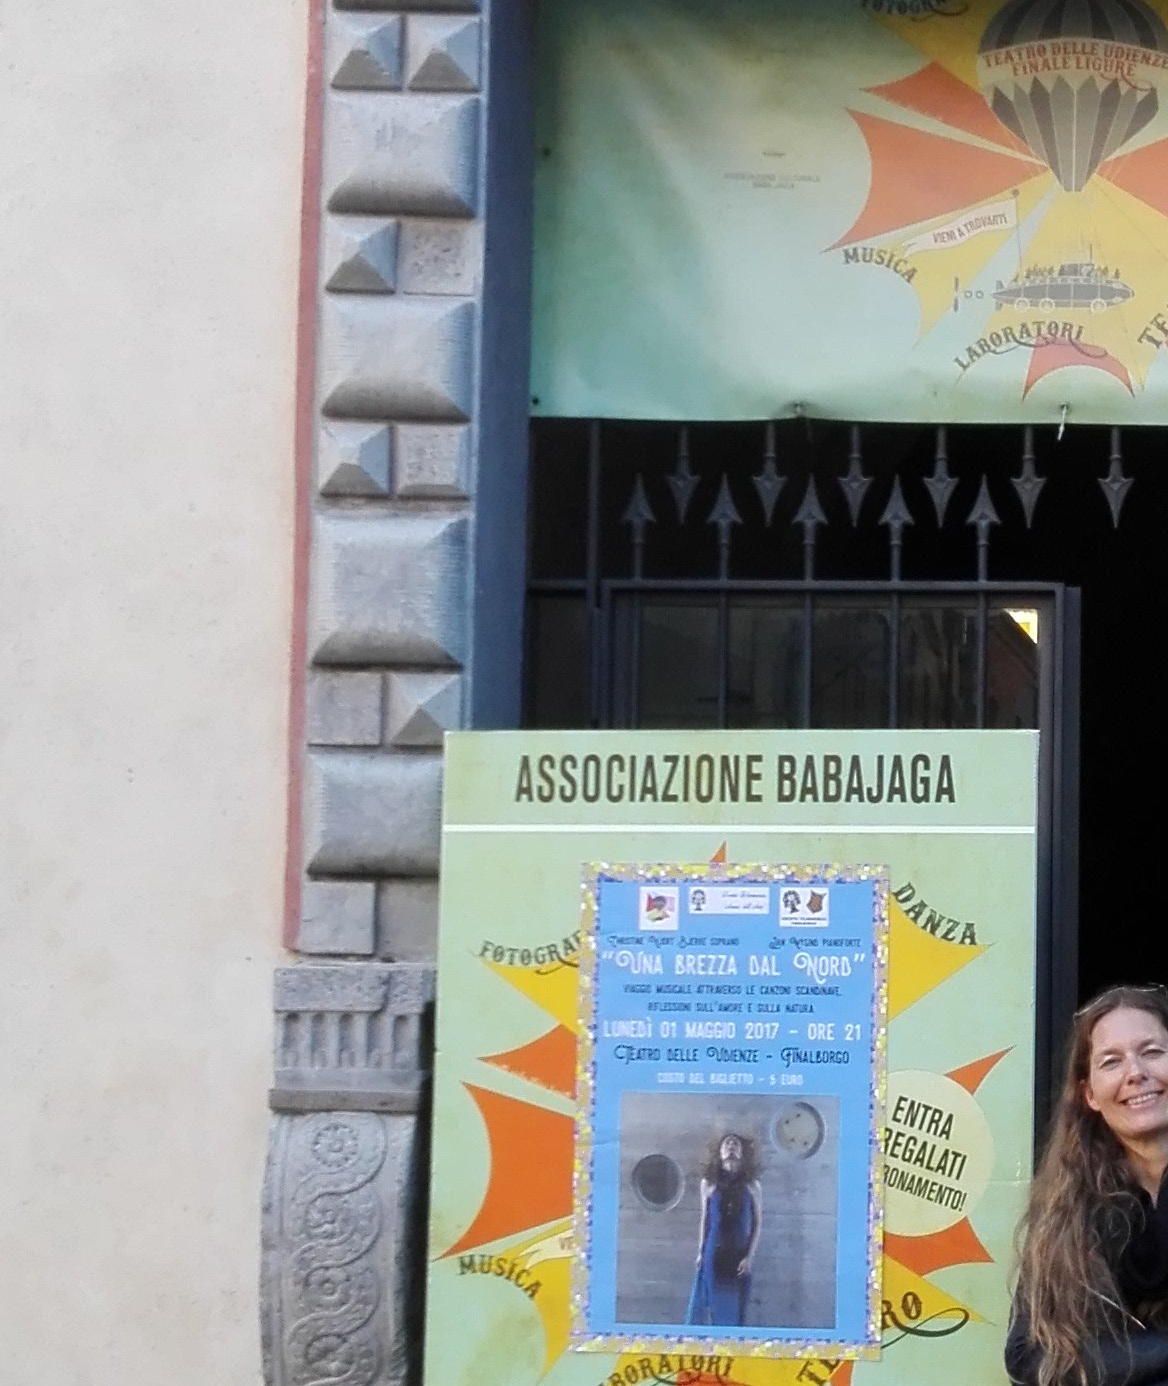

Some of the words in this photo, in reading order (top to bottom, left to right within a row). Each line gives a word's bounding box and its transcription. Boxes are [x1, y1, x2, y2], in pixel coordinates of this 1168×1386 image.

[984, 43, 1047, 67] TEATRO
[1051, 41, 1099, 56] DELLE
[1013, 56, 1073, 77] FINALE
[1075, 56, 1150, 84] LIGURE
[958, 227, 967, 238] A
[842, 246, 918, 283] MUSICA
[953, 319, 1106, 371] LABORATORI
[514, 753, 763, 804] ASSOCIAZIONE
[777, 753, 957, 804] BABAJAGA
[892, 881, 978, 946] DANZA
[674, 954, 738, 977] BREZZA
[749, 955, 781, 977] DAL
[656, 983, 692, 995] MUSICALE
[696, 984, 742, 995] ATTRAVERSO
[745, 984, 756, 995] LE
[760, 985, 791, 996] CANZONI
[747, 1002, 753, 1013] E
[757, 1003, 781, 1014] SULLA
[603, 1016, 652, 1038] LUNEDÌ
[659, 1020, 678, 1039] 01
[685, 1020, 736, 1040] MAGGIO
[745, 1022, 780, 1040] 2017
[807, 1023, 836, 1041] ORE
[844, 1023, 862, 1041] 21
[613, 1044, 661, 1065] TEATRO
[667, 1047, 699, 1063] DELLE
[706, 1045, 759, 1064] UDIENZE
[780, 1046, 850, 1068] FINALBORGO
[891, 1095, 954, 1141] ENTRA
[884, 1126, 968, 1181] REGALATI
[458, 1253, 543, 1300] MUSICA
